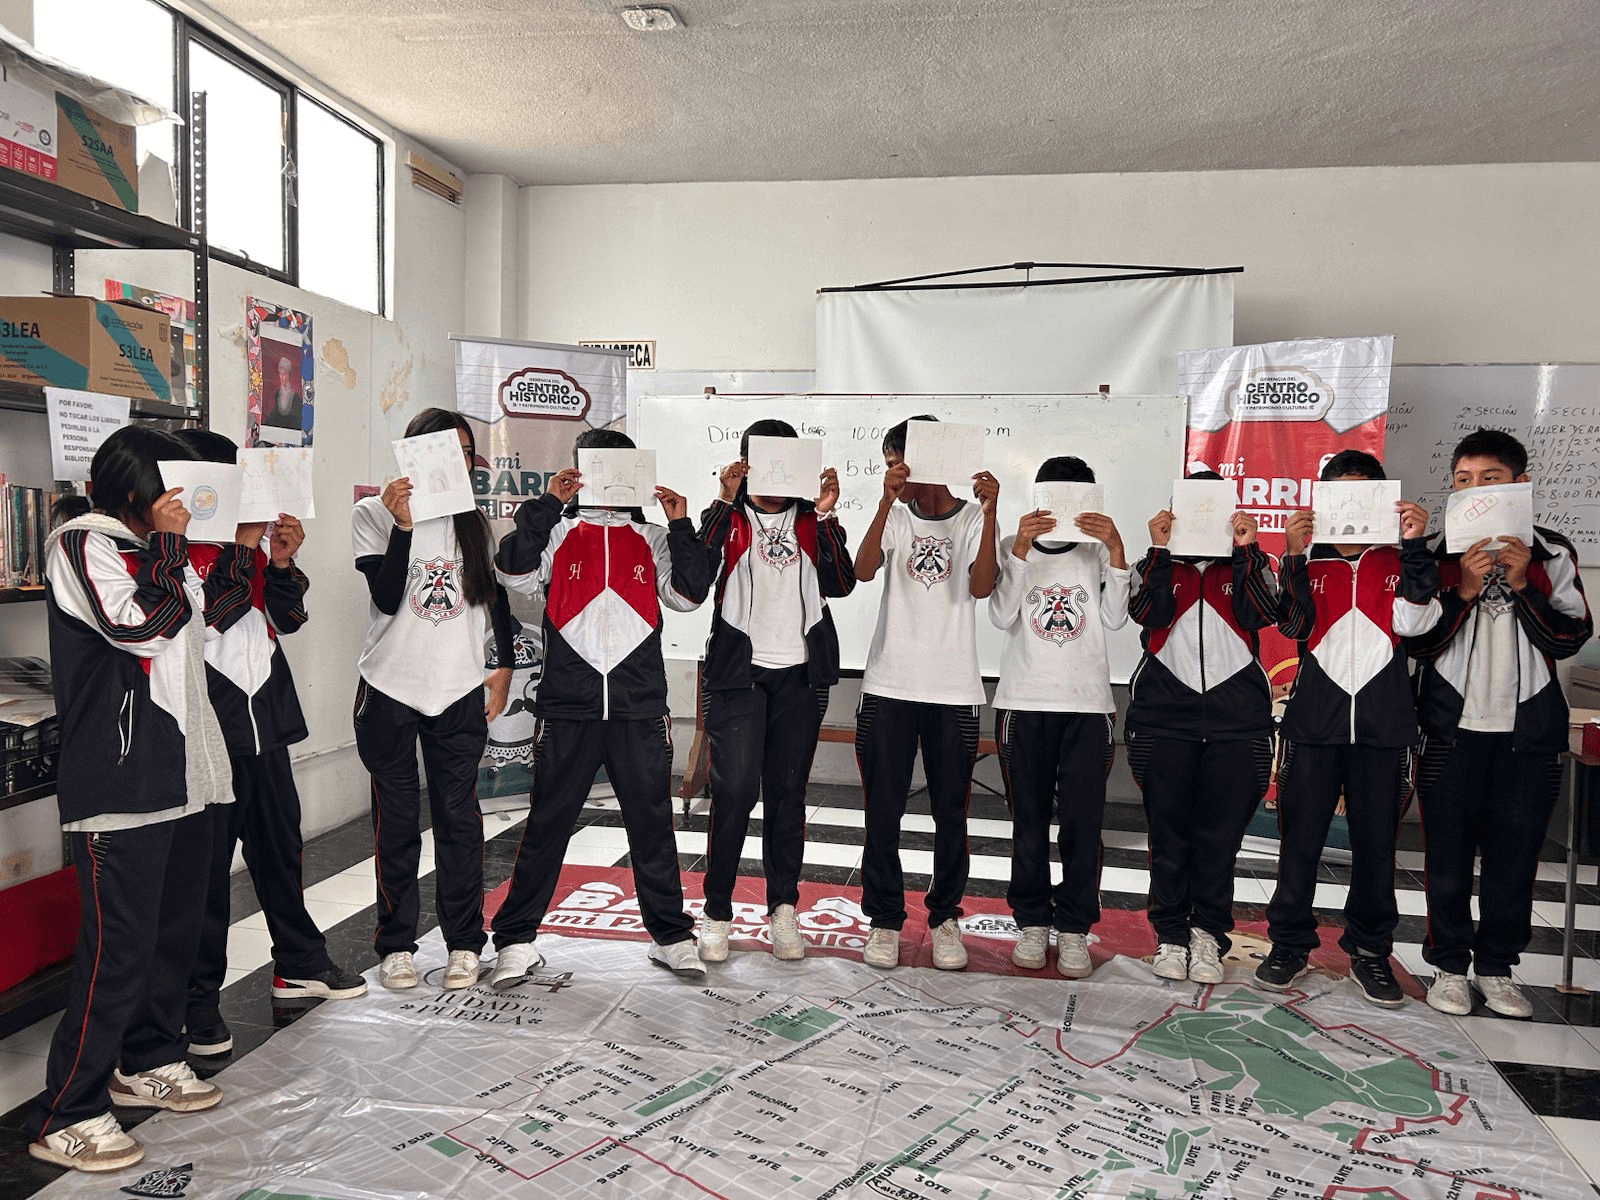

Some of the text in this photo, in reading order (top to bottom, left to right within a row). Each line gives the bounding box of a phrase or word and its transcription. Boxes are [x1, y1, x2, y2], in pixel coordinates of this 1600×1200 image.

[119, 343, 154, 363] S3LEA
[517, 382, 570, 395] CENTRO
[1246, 382, 1308, 394] CENTRO
[1389, 402, 1414, 414] CIÓN
[69, 412, 87, 420] TOCAR
[61, 423, 87, 432] PEDIRLOS
[1525, 425, 1567, 438] TALLER
[62, 434, 88, 442] PERSONA
[494, 452, 521, 469] mi
[1218, 457, 1245, 476] mi
[846, 459, 882, 477] 5 de
[568, 561, 646, 584] H R
[1310, 574, 1400, 594] H R
[550, 914, 600, 926] mi
[702, 989, 716, 998] AV
[416, 1004, 521, 1025] PUEBLA
[603, 1041, 643, 1061] AV PTE
[949, 1043, 972, 1053] PTE
[979, 1041, 1001, 1051] PTE
[858, 1052, 879, 1061] PTE
[564, 1065, 586, 1076] SUR
[616, 1063, 658, 1082] AV PTE
[1063, 1068, 1086, 1081] OTE
[1134, 1063, 1158, 1074] NTE
[593, 1067, 631, 1086] JUÁREZ
[1042, 1074, 1067, 1085] OTE
[1116, 1071, 1137, 1083] OTE
[488, 1081, 512, 1094] SUR
[600, 1085, 621, 1095] PTE
[656, 1084, 677, 1095] SUR
[823, 1076, 870, 1097] AV PTE
[1166, 1082, 1189, 1094] OTE
[578, 1089, 600, 1101] SUR
[747, 1089, 799, 1113] REFORMA
[1051, 1089, 1076, 1101] OTE
[914, 1104, 934, 1116] NTE
[1033, 1104, 1058, 1116] OTE
[1050, 1098, 1076, 1111] OTE
[1128, 1097, 1151, 1112] OTE
[546, 1108, 568, 1122] PTE
[595, 1115, 618, 1128] PTE
[764, 1111, 787, 1123] PTE
[1005, 1108, 1045, 1124] 12 OTE
[1127, 1111, 1154, 1123] OTE
[1347, 1115, 1377, 1126] OTE
[1002, 1123, 1020, 1136] NTE
[1064, 1122, 1080, 1135] NTE
[1130, 1120, 1167, 1137] CENTRAL
[1263, 1123, 1290, 1141] OTE
[408, 1131, 435, 1146] SUR
[741, 1133, 765, 1145] PTE
[1121, 1132, 1160, 1150] CENTRAL
[1139, 1132, 1165, 1145] OTE
[496, 1140, 519, 1155] PTE
[542, 1145, 565, 1159] PTE
[595, 1143, 621, 1156] SUR
[668, 1135, 720, 1159] AV PTE
[803, 1146, 829, 1158] PTE
[916, 1128, 980, 1171] AYUNTAMIENTO
[1021, 1140, 1049, 1155] OTE
[1086, 1136, 1164, 1168] PRIMERA CENTRAL
[1208, 1143, 1258, 1160] 20 OTE
[1222, 1137, 1270, 1154] 22 OTE
[1070, 1148, 1098, 1160] OTE
[1184, 1145, 1201, 1167] 10 OTE
[1311, 1148, 1342, 1161] OTE
[486, 1157, 509, 1174] PTE
[756, 1158, 782, 1171] PTE
[870, 1139, 938, 1185] AYUNTAMIENTO
[989, 1154, 1016, 1171] OTE
[1026, 1159, 1054, 1173] OTE
[1416, 1157, 1432, 1170] NTE
[606, 1163, 632, 1180] SUR
[1227, 1159, 1250, 1182] 14 NTE
[1332, 1164, 1353, 1185] 18 NTE
[1371, 1162, 1404, 1176] OTE
[1465, 1166, 1494, 1176] NTE
[1205, 1169, 1221, 1185] OTE
[1265, 1169, 1315, 1188] 18 OTE
[924, 1180, 952, 1195] OTE
[1451, 1177, 1465, 1192] NTE
